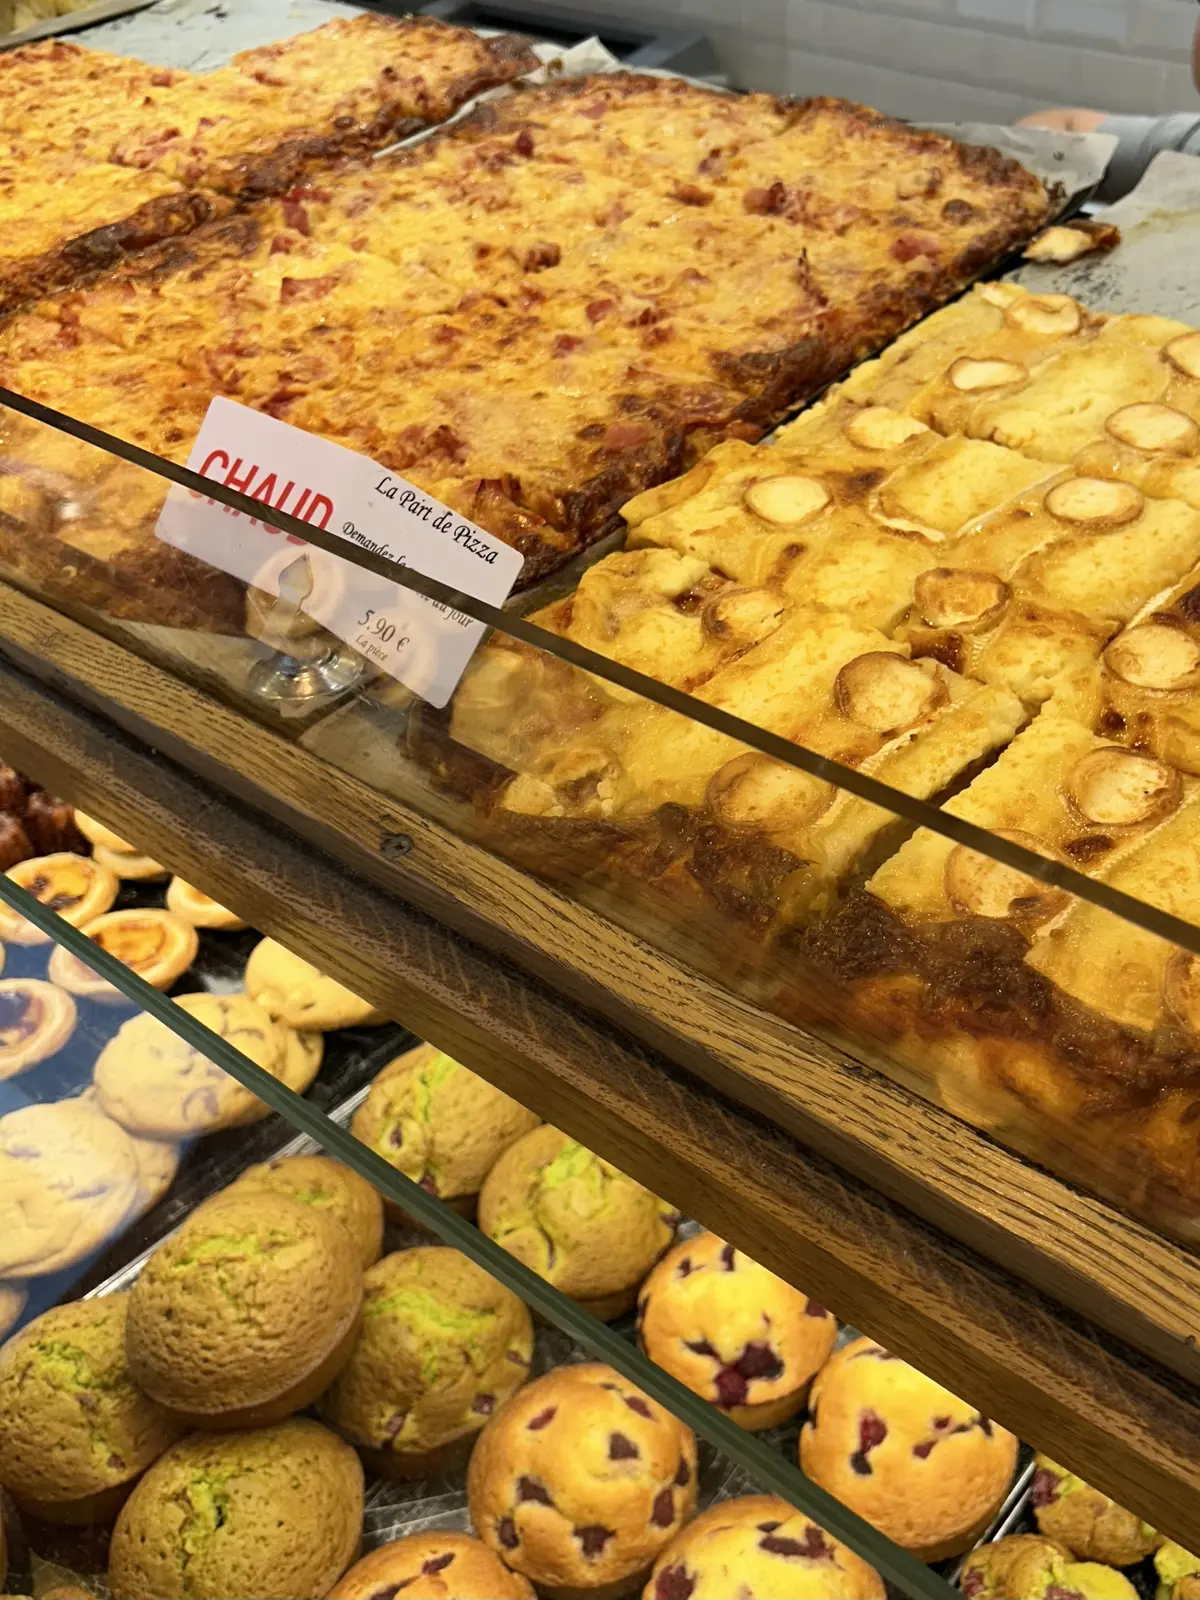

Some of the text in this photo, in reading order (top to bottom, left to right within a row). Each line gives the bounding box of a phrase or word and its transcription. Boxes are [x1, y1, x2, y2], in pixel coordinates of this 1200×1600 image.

[188, 449, 334, 545] CHAUD
[375, 476, 499, 564] La Part de Pizza
[357, 609, 411, 652] 5.90 €
[443, 608, 474, 628] jour
[355, 634, 389, 662] La pièce
